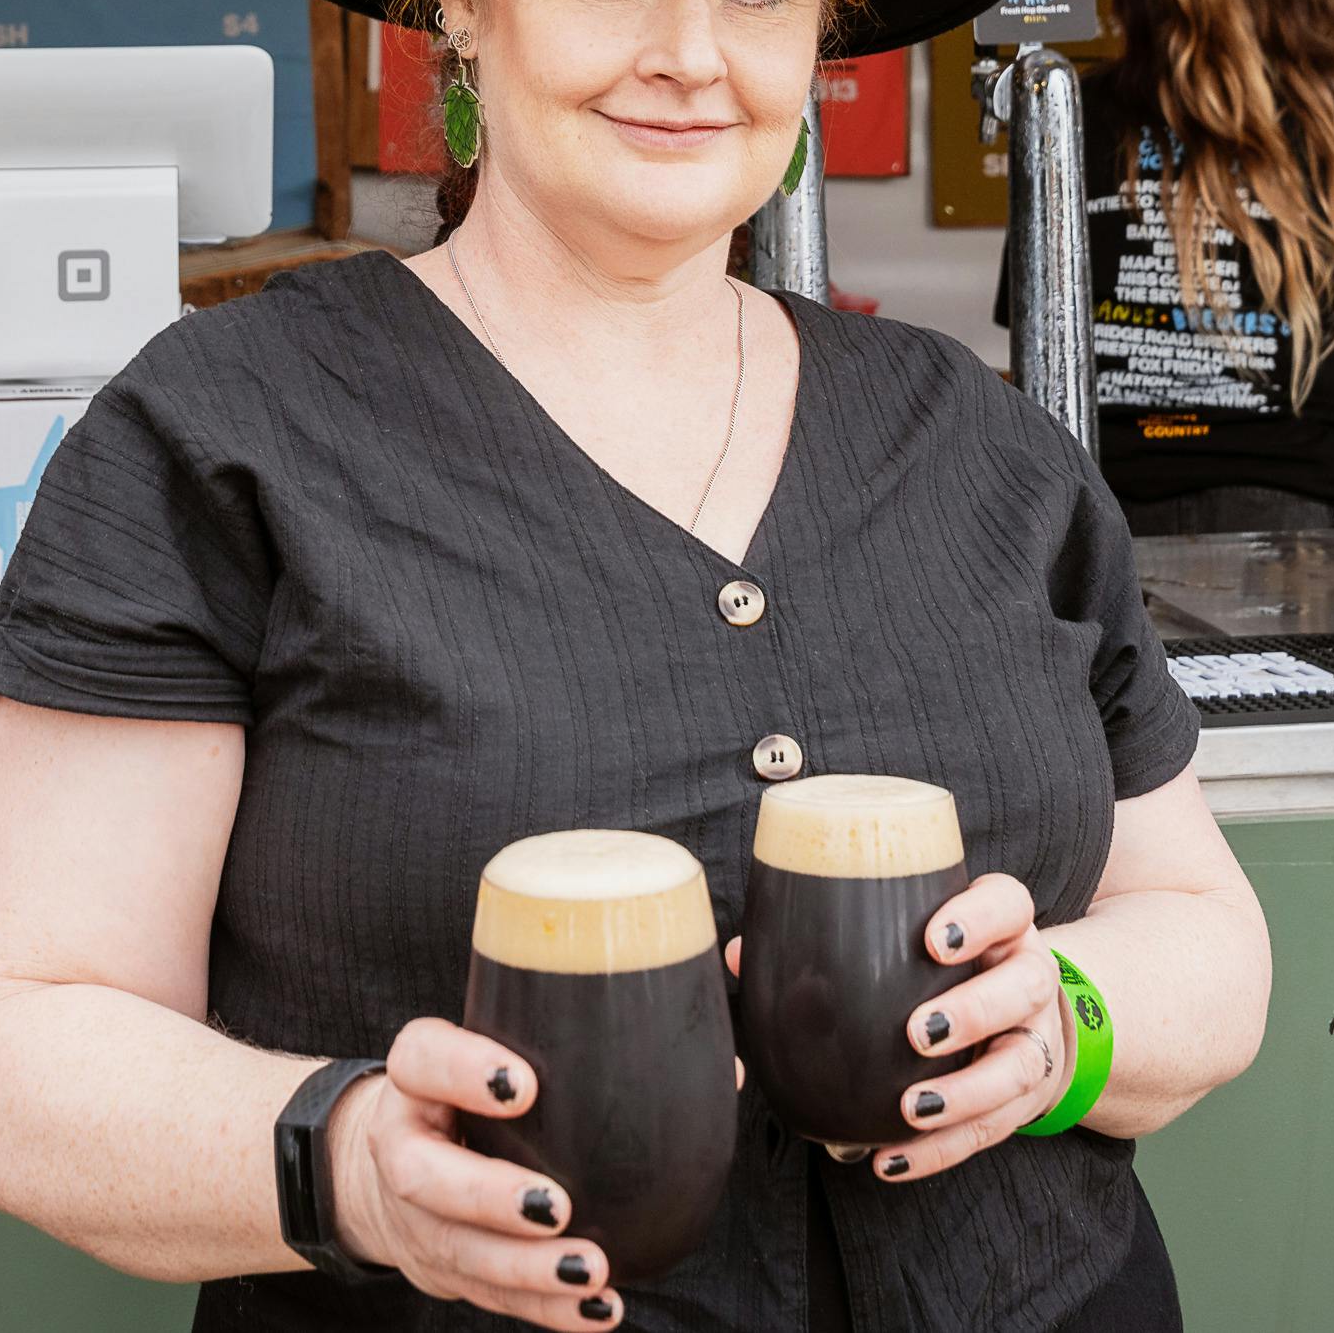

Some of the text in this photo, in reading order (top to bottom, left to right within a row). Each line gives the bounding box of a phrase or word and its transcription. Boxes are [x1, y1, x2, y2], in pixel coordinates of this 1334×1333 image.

[223, 13, 260, 38] $4
[1120, 255, 1176, 274] MAPLE
[1118, 272, 1157, 288] MISS
[1115, 286, 1148, 303] THE
[1144, 329, 1192, 348] ROAD
[1128, 356, 1224, 377] FOX FRIDAY
